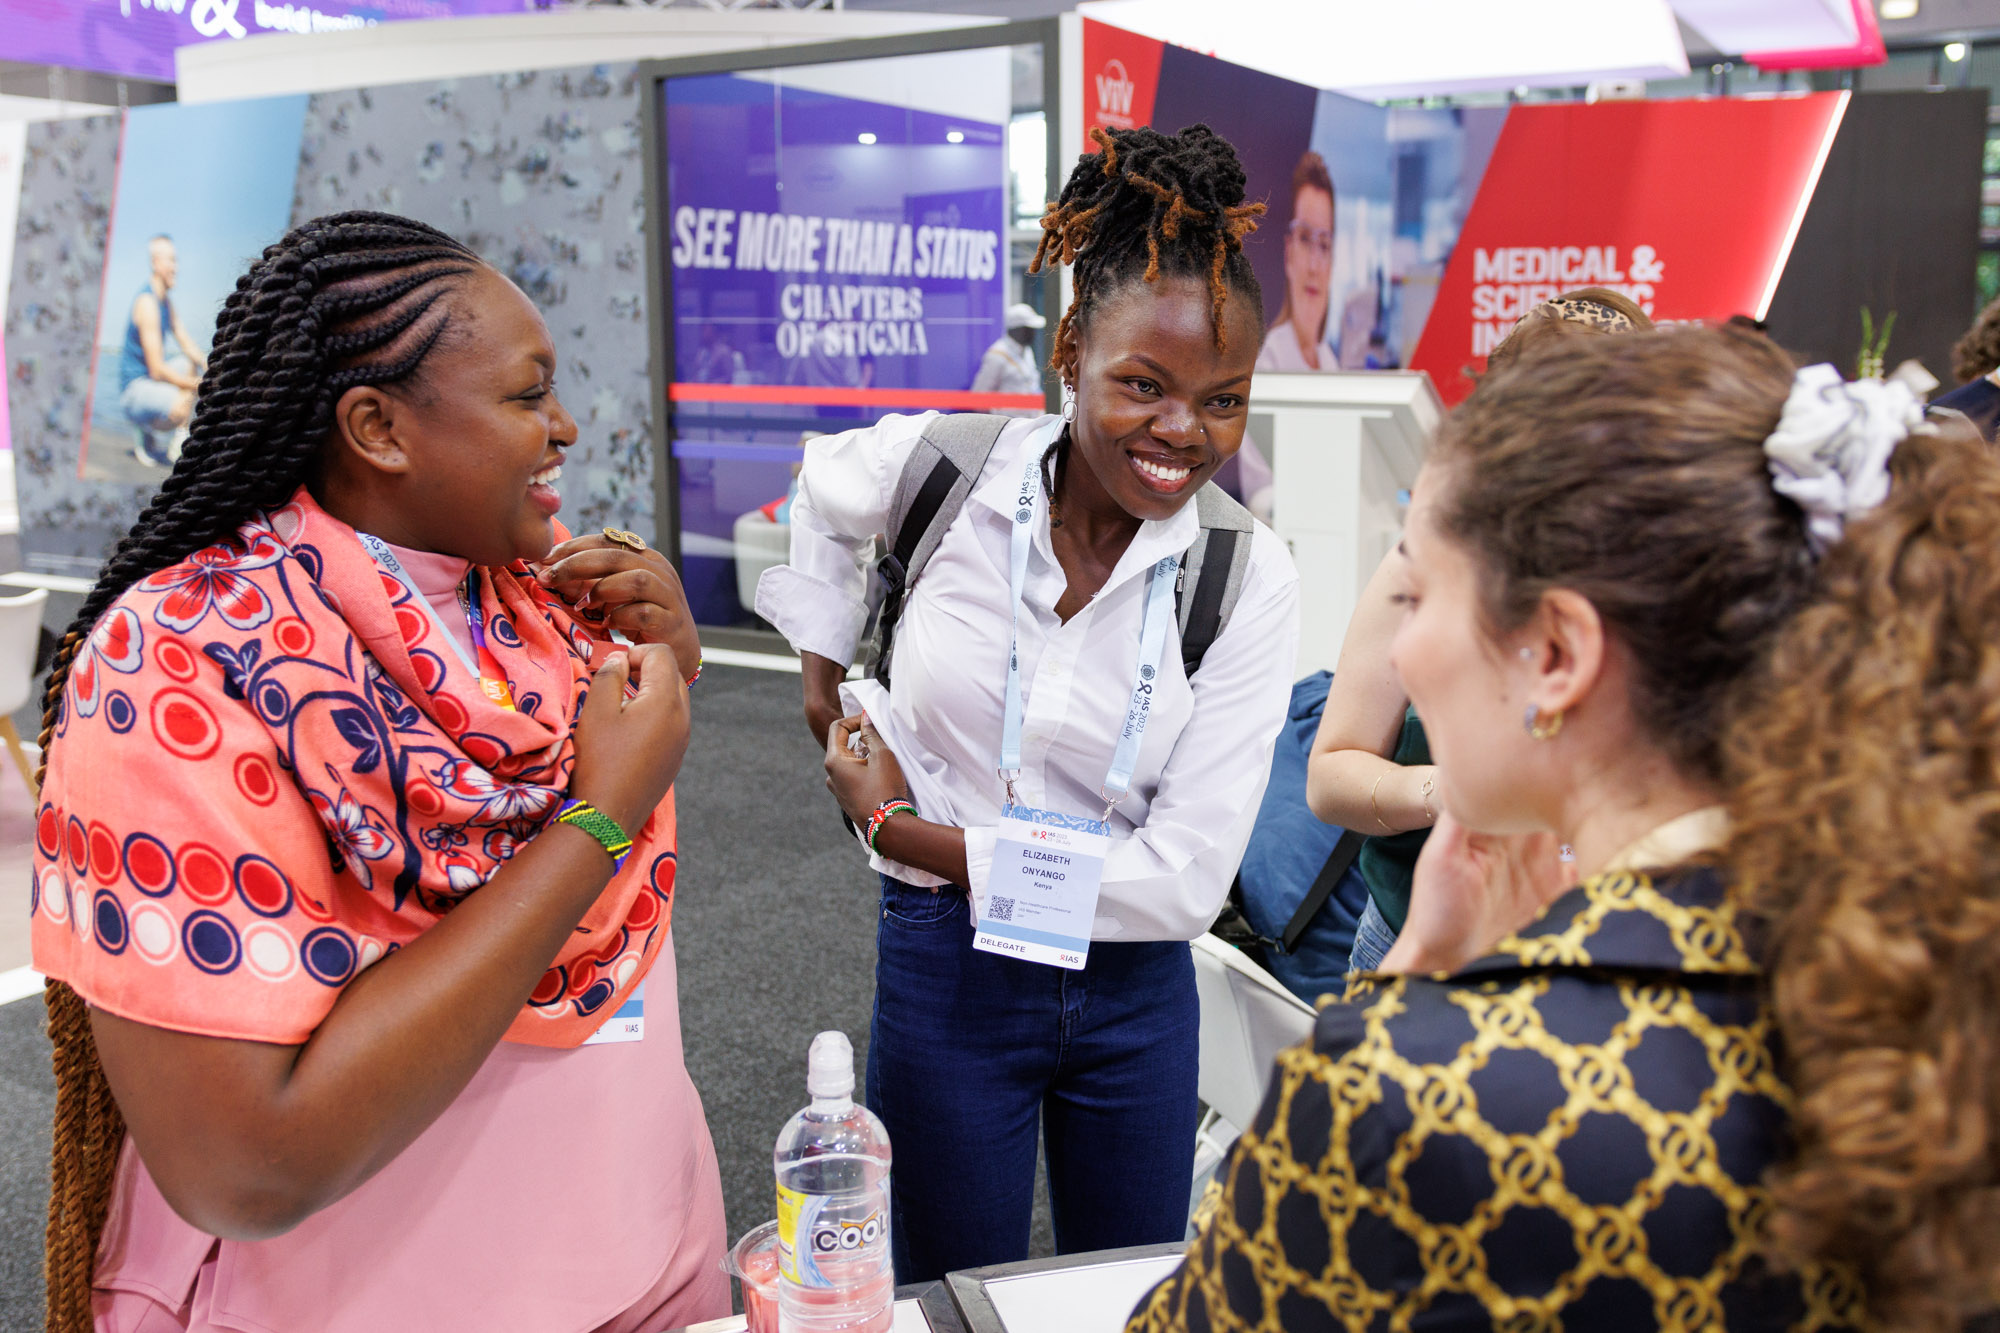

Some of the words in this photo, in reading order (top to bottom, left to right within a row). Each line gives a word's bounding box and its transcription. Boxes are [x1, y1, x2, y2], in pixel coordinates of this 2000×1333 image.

[672, 205, 736, 270] SEE
[735, 211, 822, 273] MORE
[824, 217, 895, 277] THAN
[893, 223, 913, 277] A
[914, 225, 998, 280] STATUS
[1473, 246, 1625, 284] MEDICAL
[1629, 245, 1665, 283] &
[780, 283, 924, 322] CHAPTERS
[775, 321, 818, 358] OF
[822, 320, 929, 357] STIGMA
[1024, 463, 1034, 480] 2023
[1032, 469, 1040, 479] 26
[1021, 481, 1029, 494] IAS
[1029, 484, 1037, 493] 23
[378, 549, 400, 573] 2023
[1157, 562, 1168, 578] July
[1134, 693, 1143, 705] 23
[1141, 696, 1150, 711] IAS
[1129, 710, 1138, 721] 26
[1136, 712, 1148, 733] 2023
[1123, 720, 1134, 740] July
[1022, 849, 1071, 865] ELIZABETH
[1022, 866, 1065, 881] ONYANGO
[1033, 881, 1052, 890] Kenya
[980, 937, 1026, 953] DELEGATE
[1065, 955, 1079, 964] IAS
[629, 1024, 639, 1032] IAS
